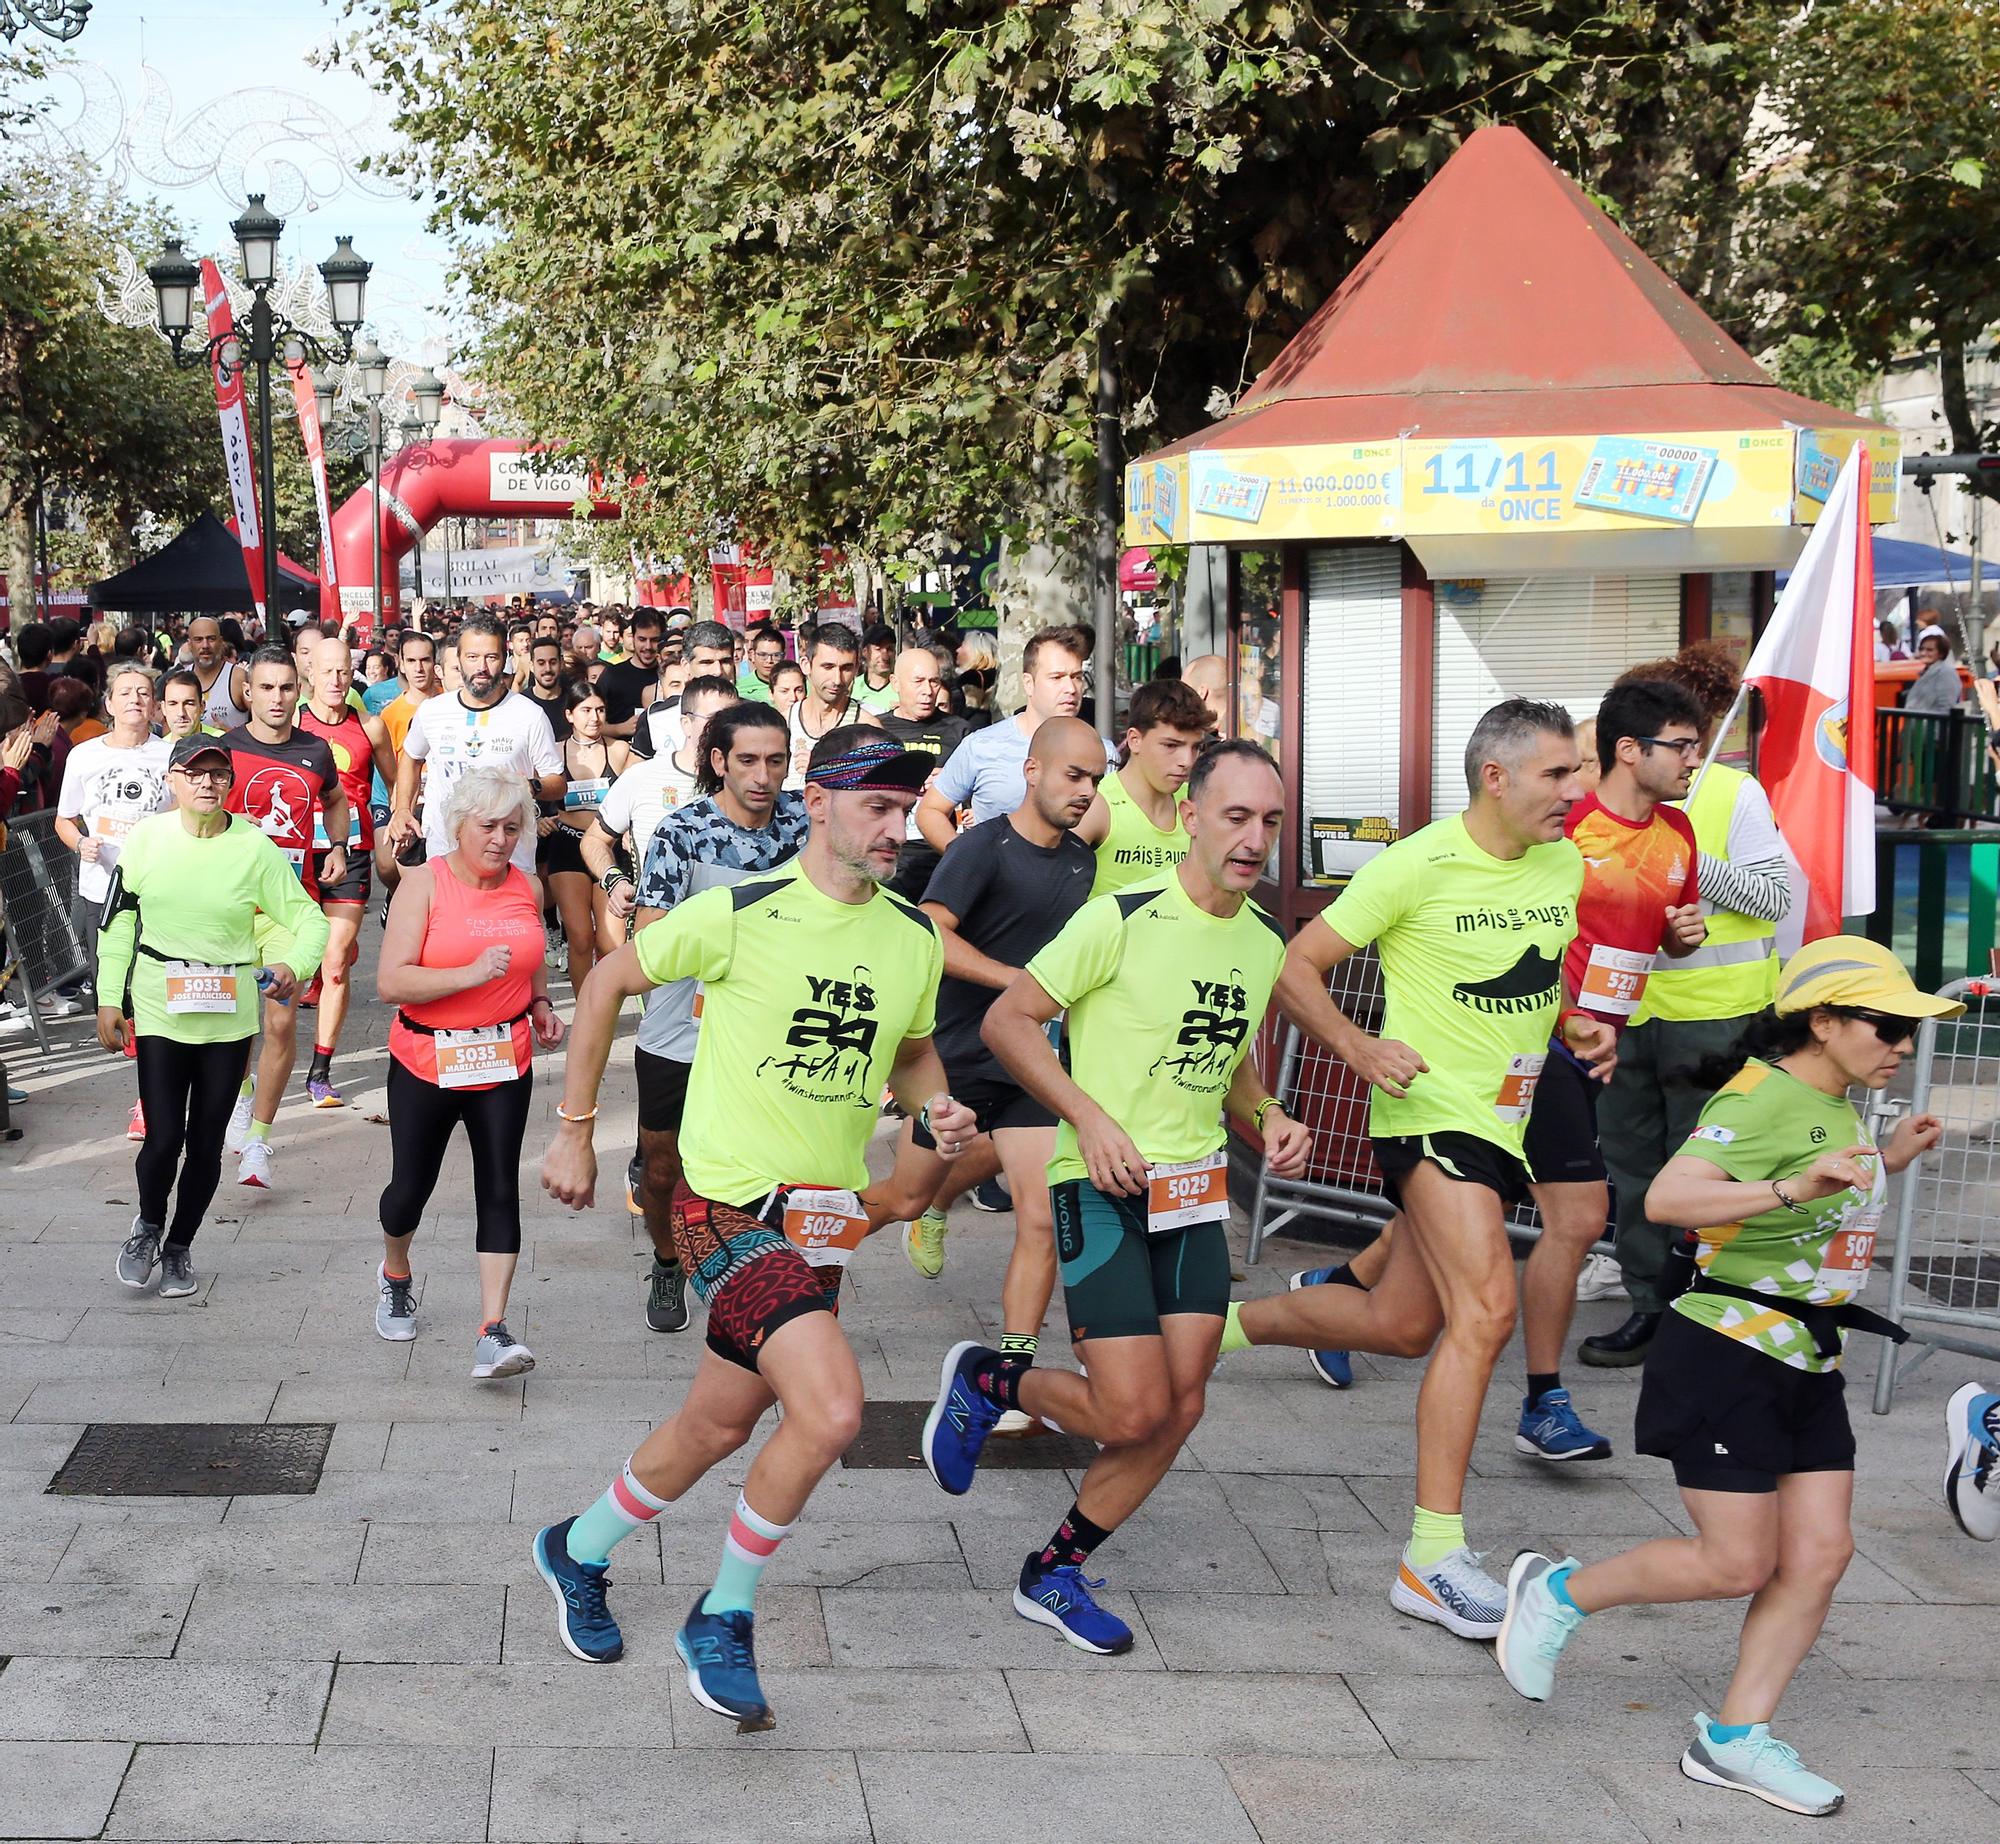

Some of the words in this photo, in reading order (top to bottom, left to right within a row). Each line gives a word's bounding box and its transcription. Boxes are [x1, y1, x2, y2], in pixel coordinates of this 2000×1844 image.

[1752, 437, 1784, 447] ONCE
[1659, 448, 1697, 461] 00000
[1422, 451, 1562, 494] 11/11
[508, 478, 527, 490] DE
[534, 479, 571, 491] VIGO
[1278, 475, 1378, 494] 11.000.000
[1380, 472, 1391, 489] €
[1326, 495, 1381, 508] 1.000.000
[1383, 494, 1391, 505] €
[1481, 497, 1495, 508] da
[1500, 498, 1561, 521] ONCE
[577, 791, 597, 802] 1115
[1362, 817, 1388, 829] EURO
[1313, 831, 1337, 840] BOTE
[1338, 832, 1350, 840] DE
[1353, 828, 1397, 841] JACKPOT
[1114, 845, 1153, 864] máis
[1456, 907, 1508, 933] máis
[1525, 905, 1570, 927] auga
[184, 978, 221, 993] 5033
[805, 975, 877, 1012] YES
[172, 993, 191, 1001] JOSE
[192, 992, 232, 1000] FRANCISCO
[1191, 979, 1248, 1012] YES
[455, 1045, 497, 1064] 5035
[446, 1062, 475, 1073] MARIA
[476, 1058, 510, 1072] CARMEN
[789, 1053, 859, 1085] TEAM
[1168, 1173, 1210, 1199] 5029
[799, 1215, 847, 1236] 5028
[1058, 1193, 1073, 1252] WONG
[1428, 1573, 1470, 1618] HOKA
